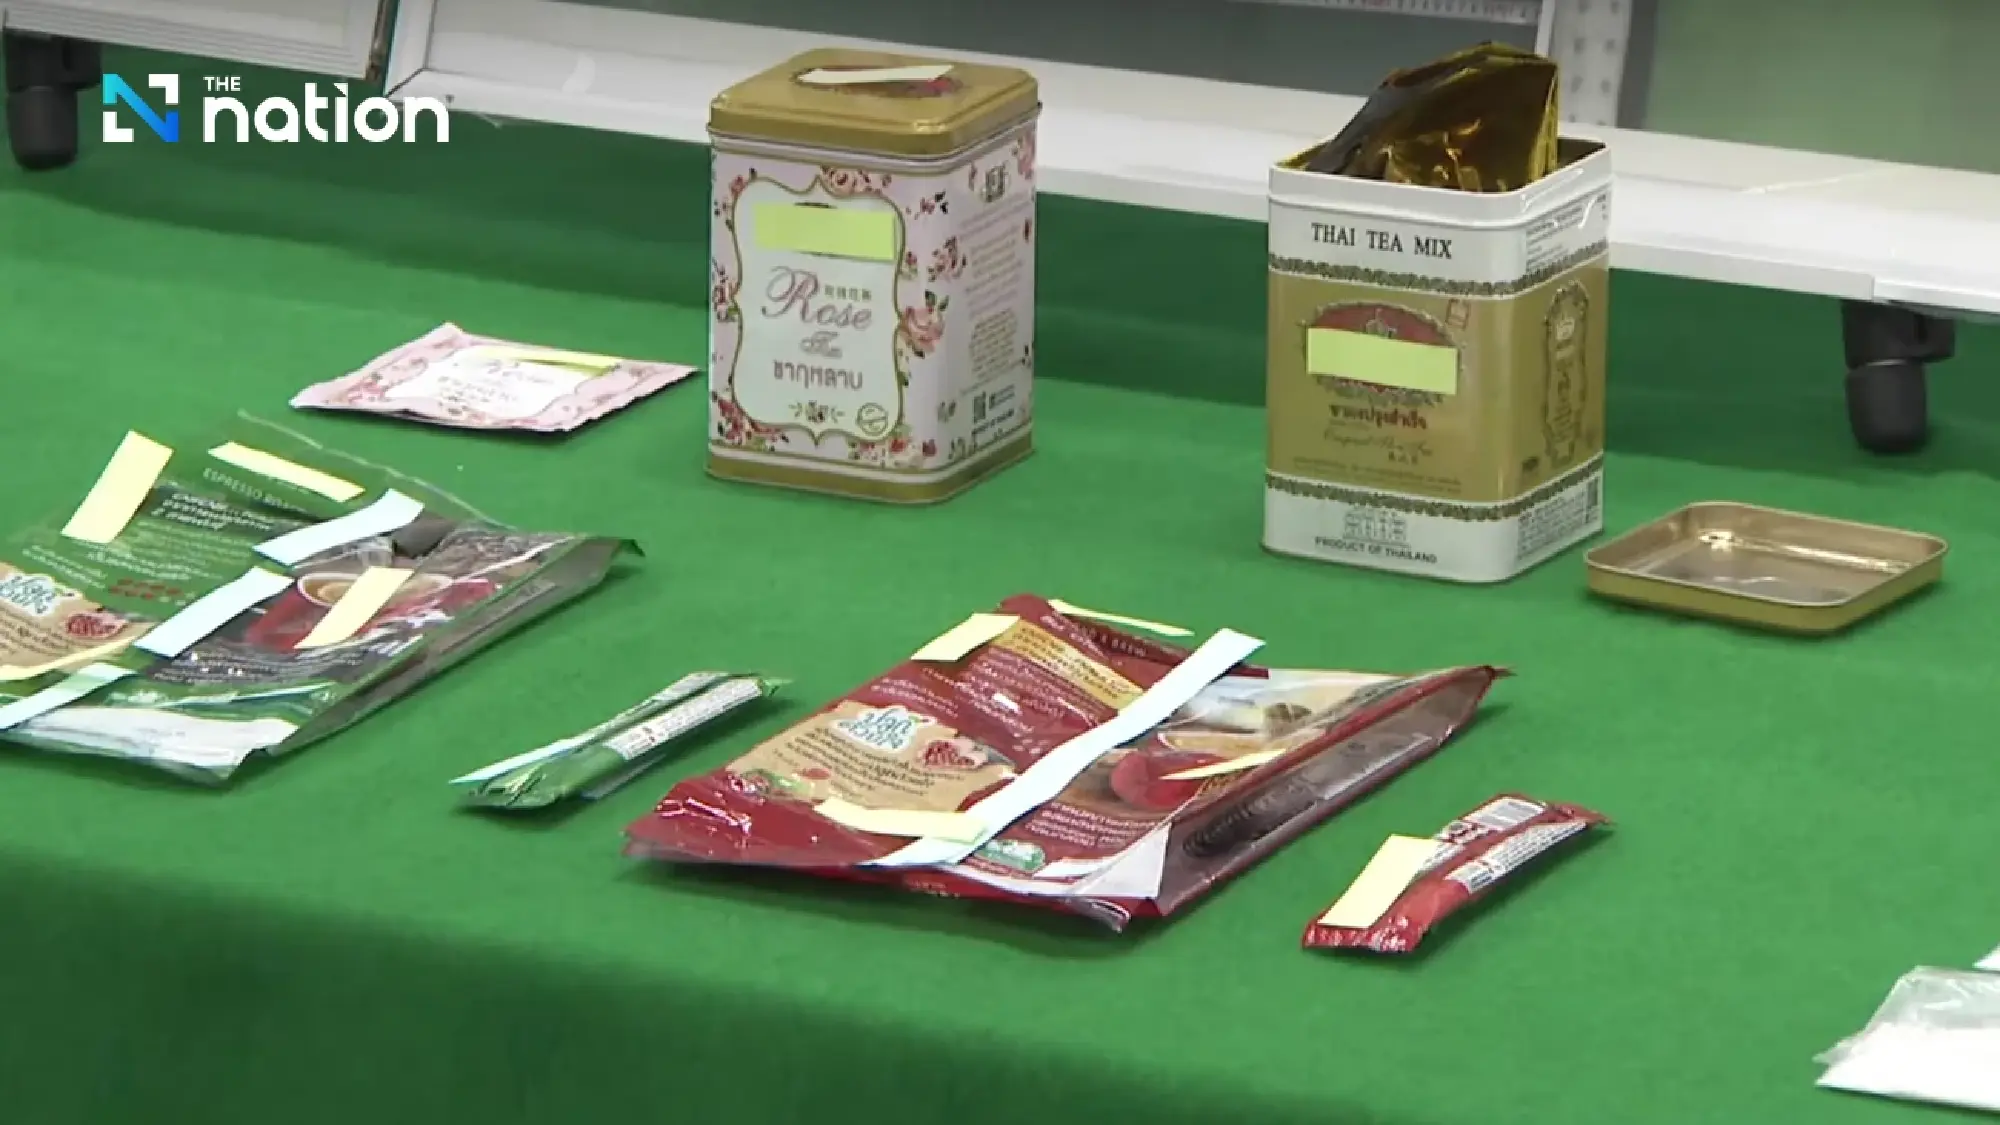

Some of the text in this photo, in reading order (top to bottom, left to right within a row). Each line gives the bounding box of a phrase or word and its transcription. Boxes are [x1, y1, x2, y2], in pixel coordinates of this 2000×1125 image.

[1311, 222, 1452, 260] THAI TEA MIX
[762, 266, 873, 331] Rose
[202, 467, 263, 501] ESPRESSO
[1314, 536, 1437, 564] PRODUCT OF THAILAND
